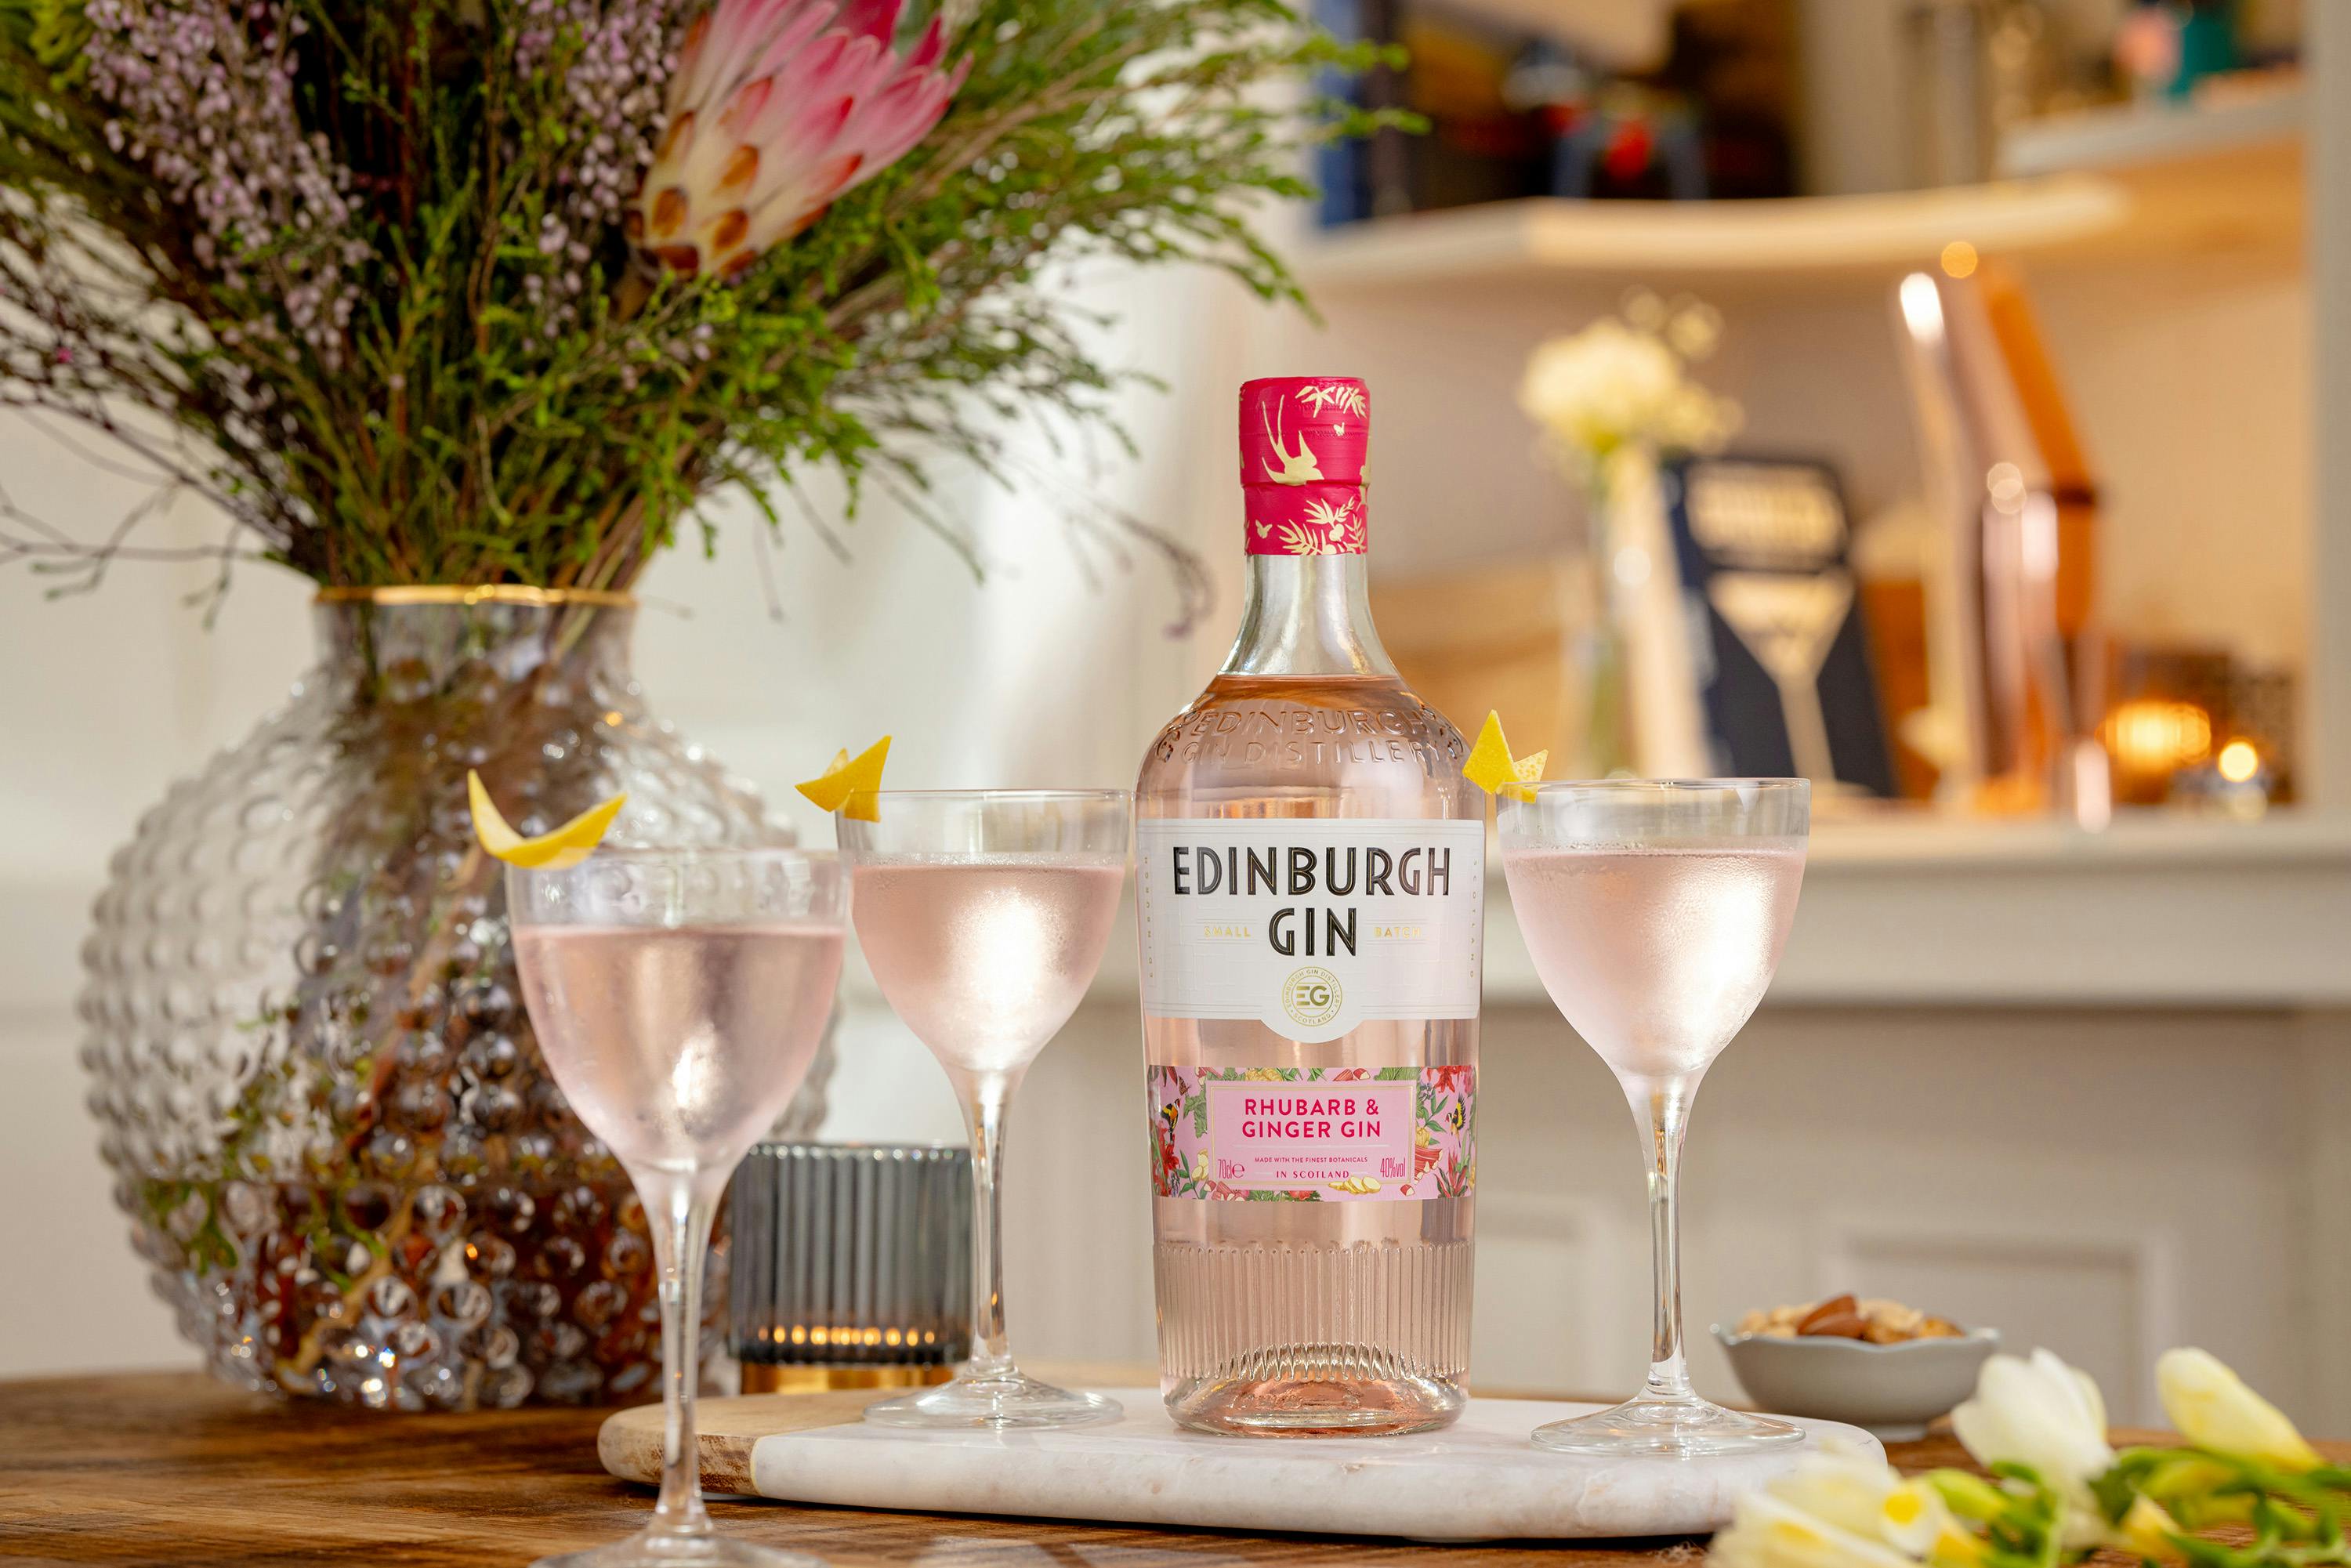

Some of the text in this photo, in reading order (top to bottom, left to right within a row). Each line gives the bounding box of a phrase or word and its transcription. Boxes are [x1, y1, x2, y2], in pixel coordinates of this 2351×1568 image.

[1190, 708, 1431, 736] EDINBURGH
[1181, 739, 1441, 766] GIN DISTILLERY
[1172, 846, 1451, 896] EDINBURGH
[1204, 925, 1422, 938] SMALL BATCH
[1268, 907, 1357, 957] GIN
[1297, 985, 1330, 1006] EG
[1294, 1013, 1331, 1024] SCOTLAND
[1244, 1099, 1379, 1116] RHUBARB &
[1242, 1121, 1380, 1138] GINGER GIN
[1276, 1170, 1349, 1179] IN SCOTLAND
